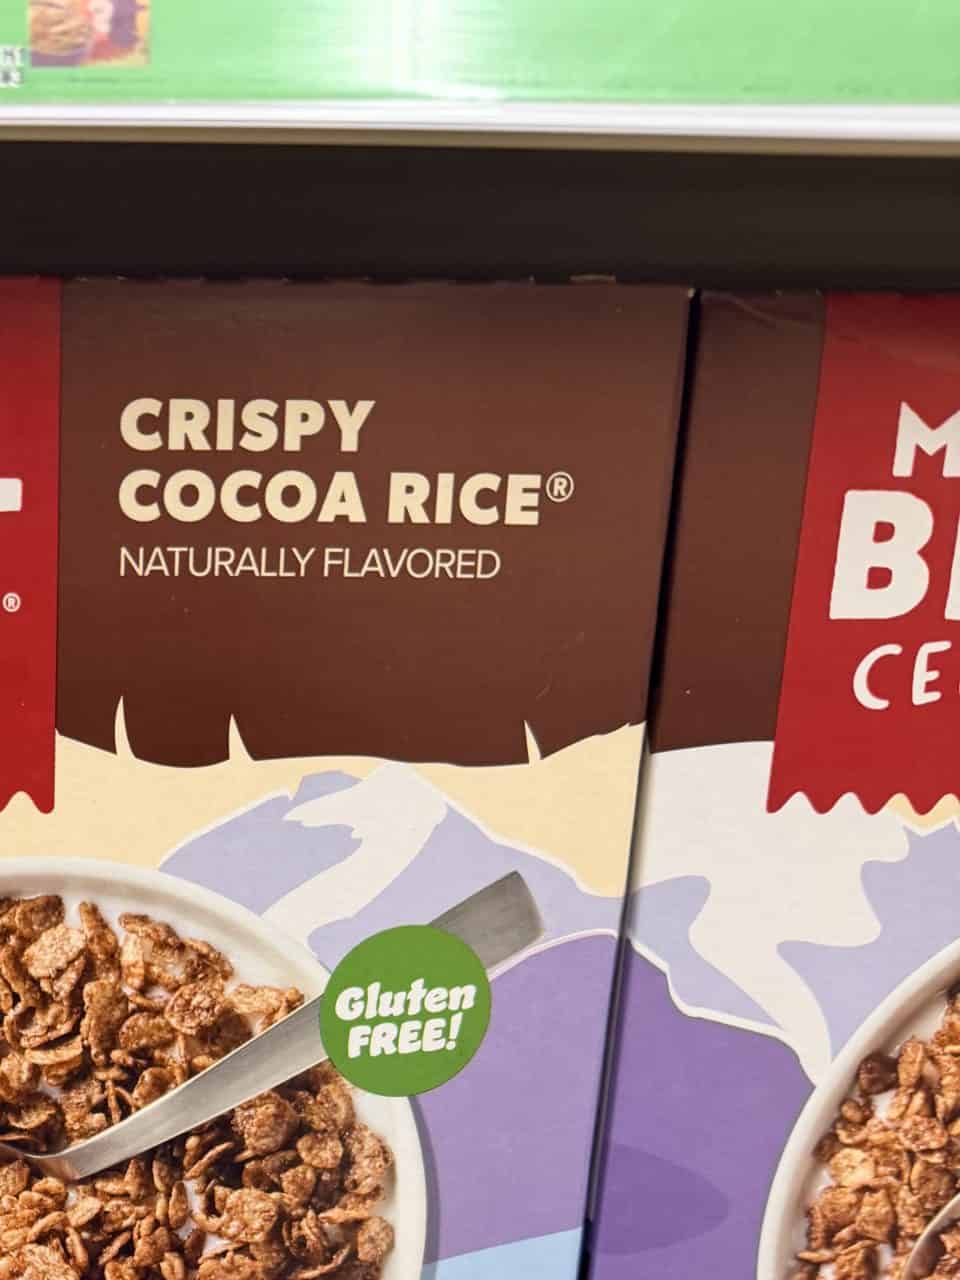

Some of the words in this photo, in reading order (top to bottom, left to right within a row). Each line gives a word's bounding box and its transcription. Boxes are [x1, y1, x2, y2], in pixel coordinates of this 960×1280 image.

[119, 397, 376, 452] CRISPY
[118, 469, 367, 524] COCOA
[119, 546, 315, 578] NATURALLY
[322, 547, 501, 580] FLAVORED
[335, 978, 477, 1021] Gluten
[347, 1012, 463, 1059] FREE!
